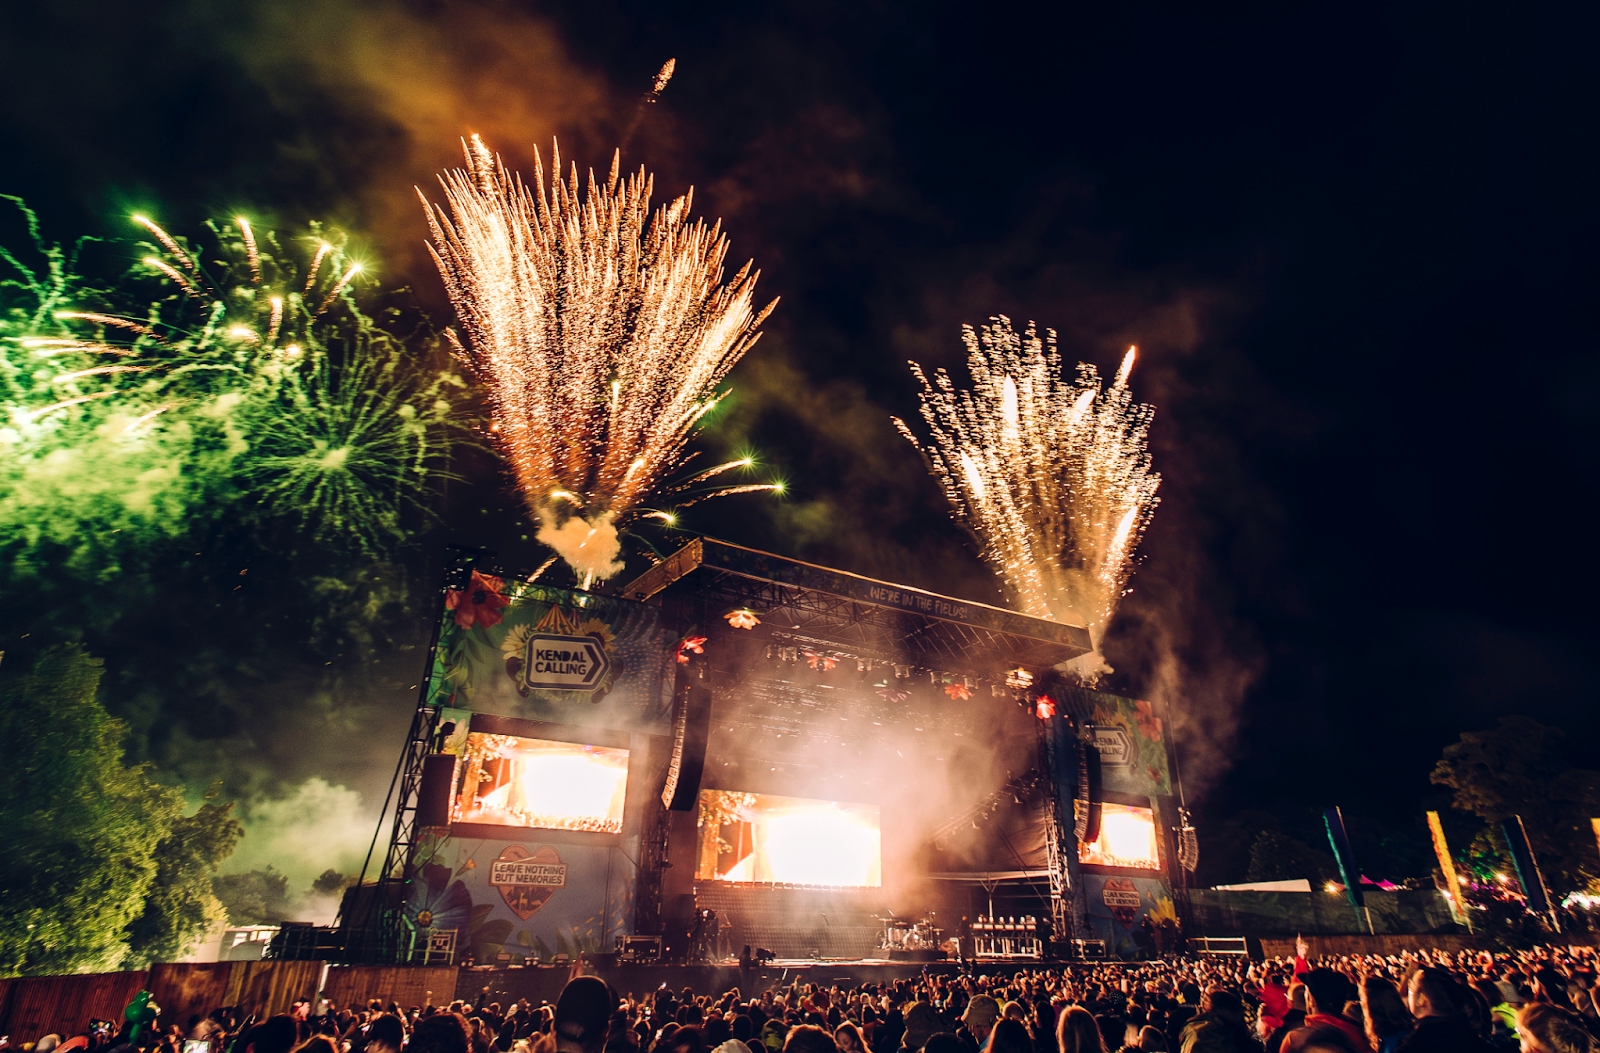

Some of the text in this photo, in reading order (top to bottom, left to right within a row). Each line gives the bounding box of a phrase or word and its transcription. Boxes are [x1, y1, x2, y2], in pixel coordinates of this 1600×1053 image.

[870, 586, 968, 619] WE'RE IN THE FIELDS!
[536, 649, 587, 663] KENDAL
[535, 662, 587, 675] CALLING
[494, 863, 565, 875] LEAVE NOTHING
[495, 873, 562, 884] BUT MEMORIES
